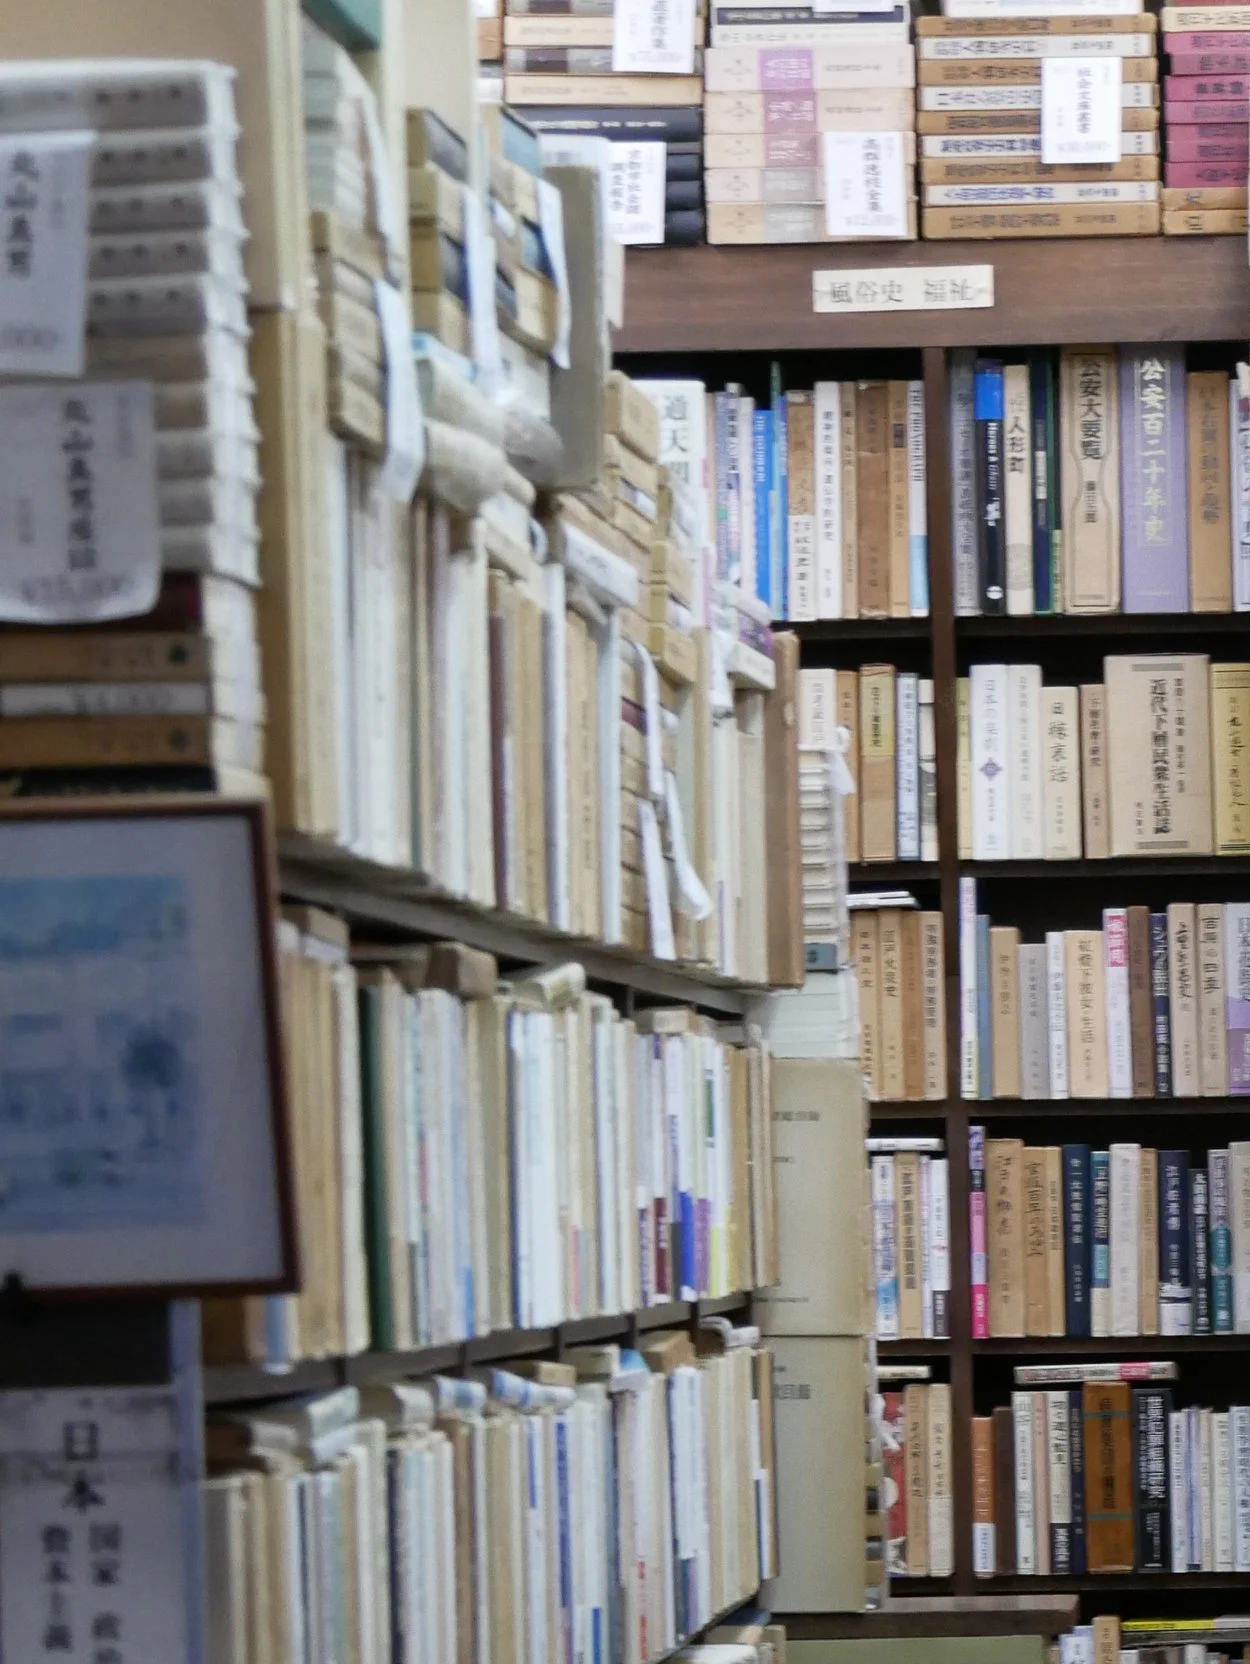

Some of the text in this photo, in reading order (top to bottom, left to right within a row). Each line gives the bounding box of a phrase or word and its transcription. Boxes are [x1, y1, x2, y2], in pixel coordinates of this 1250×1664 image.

[829, 277, 973, 305] 風俗史 福祉
[1139, 356, 1167, 543] 公安百二十年史
[62, 1421, 105, 1515] 日本
